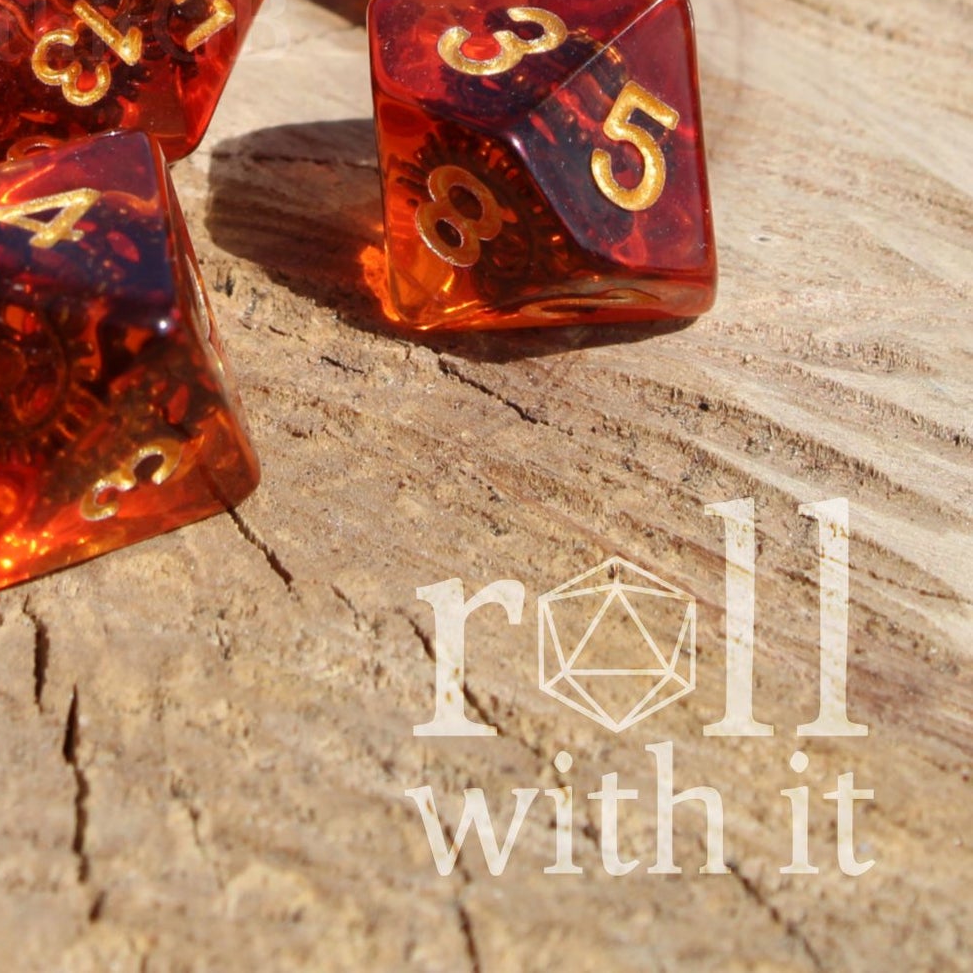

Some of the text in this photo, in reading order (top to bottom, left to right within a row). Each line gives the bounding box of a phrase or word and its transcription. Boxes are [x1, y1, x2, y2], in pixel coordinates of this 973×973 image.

[31, 0, 143, 107] 13
[437, 6, 568, 76] 3
[591, 79, 680, 212] 5
[415, 164, 503, 268] 8
[79, 438, 182, 522] 3
